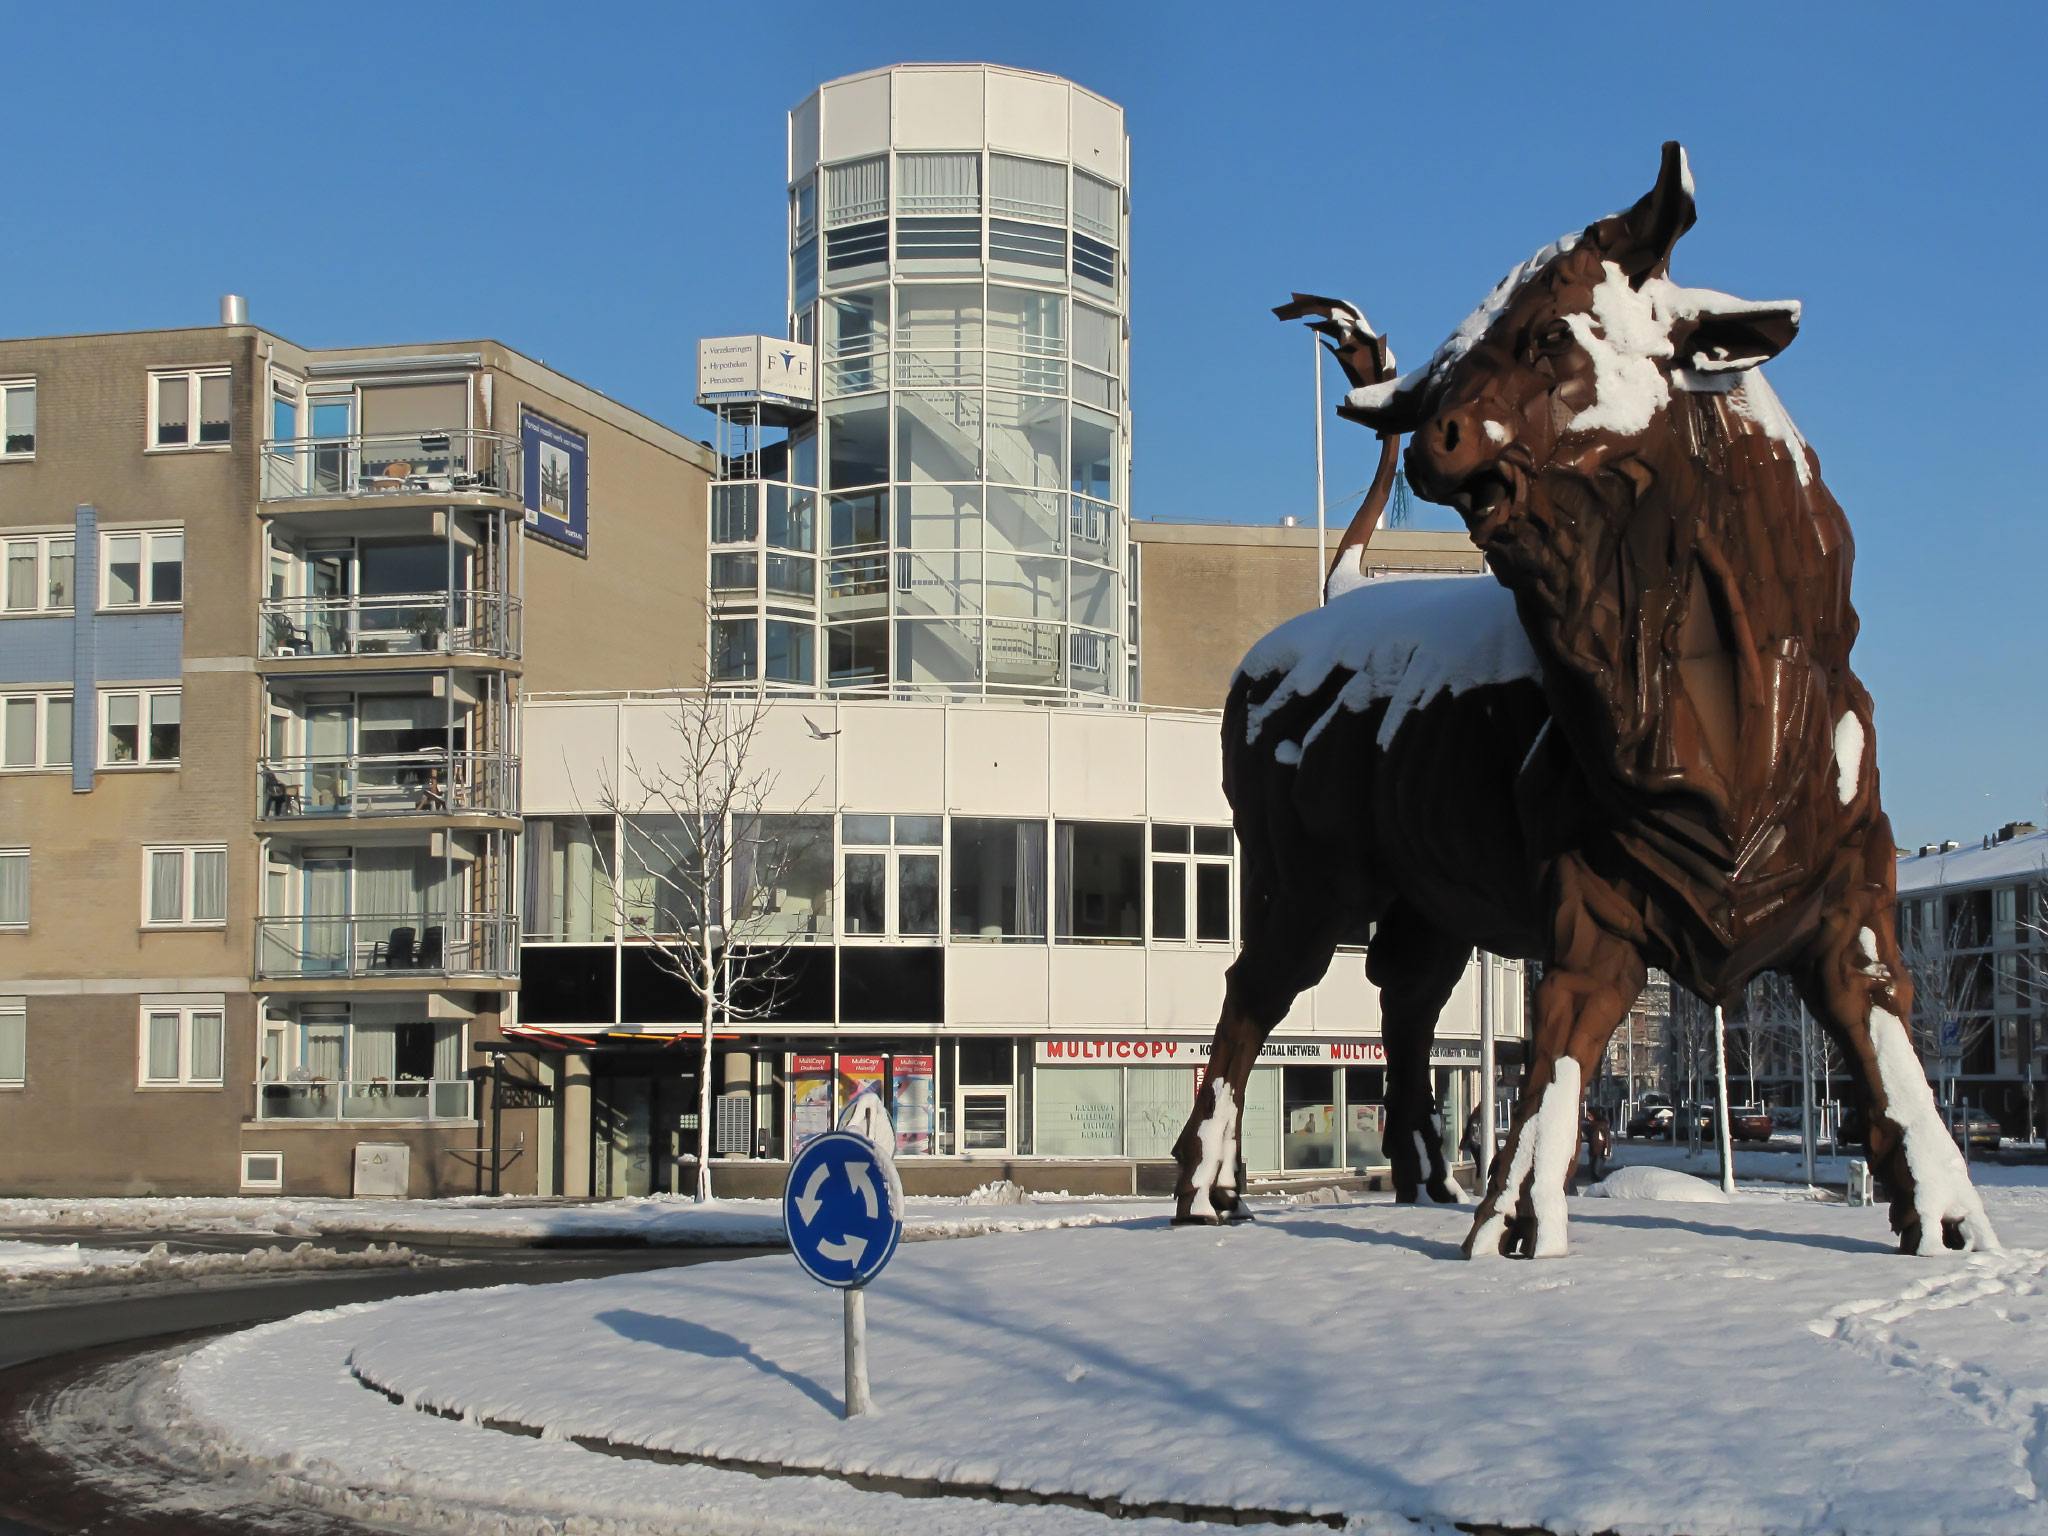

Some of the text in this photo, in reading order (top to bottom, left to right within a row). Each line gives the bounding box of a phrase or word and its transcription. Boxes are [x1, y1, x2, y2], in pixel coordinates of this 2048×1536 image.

[710, 345, 752, 354] Verzekeringen
[710, 361, 747, 370] Hypotheken
[710, 376, 744, 384] Pensioenen
[1047, 1041, 1178, 1058] MULTICOPY
[1199, 1044, 1321, 1057] KO GITAAL NETWERK
[798, 1057, 826, 1066] MultiCopy
[851, 1057, 880, 1066] MultiCopy
[900, 1058, 927, 1067] MultiCopy
[1196, 1067, 1205, 1095] MUL
